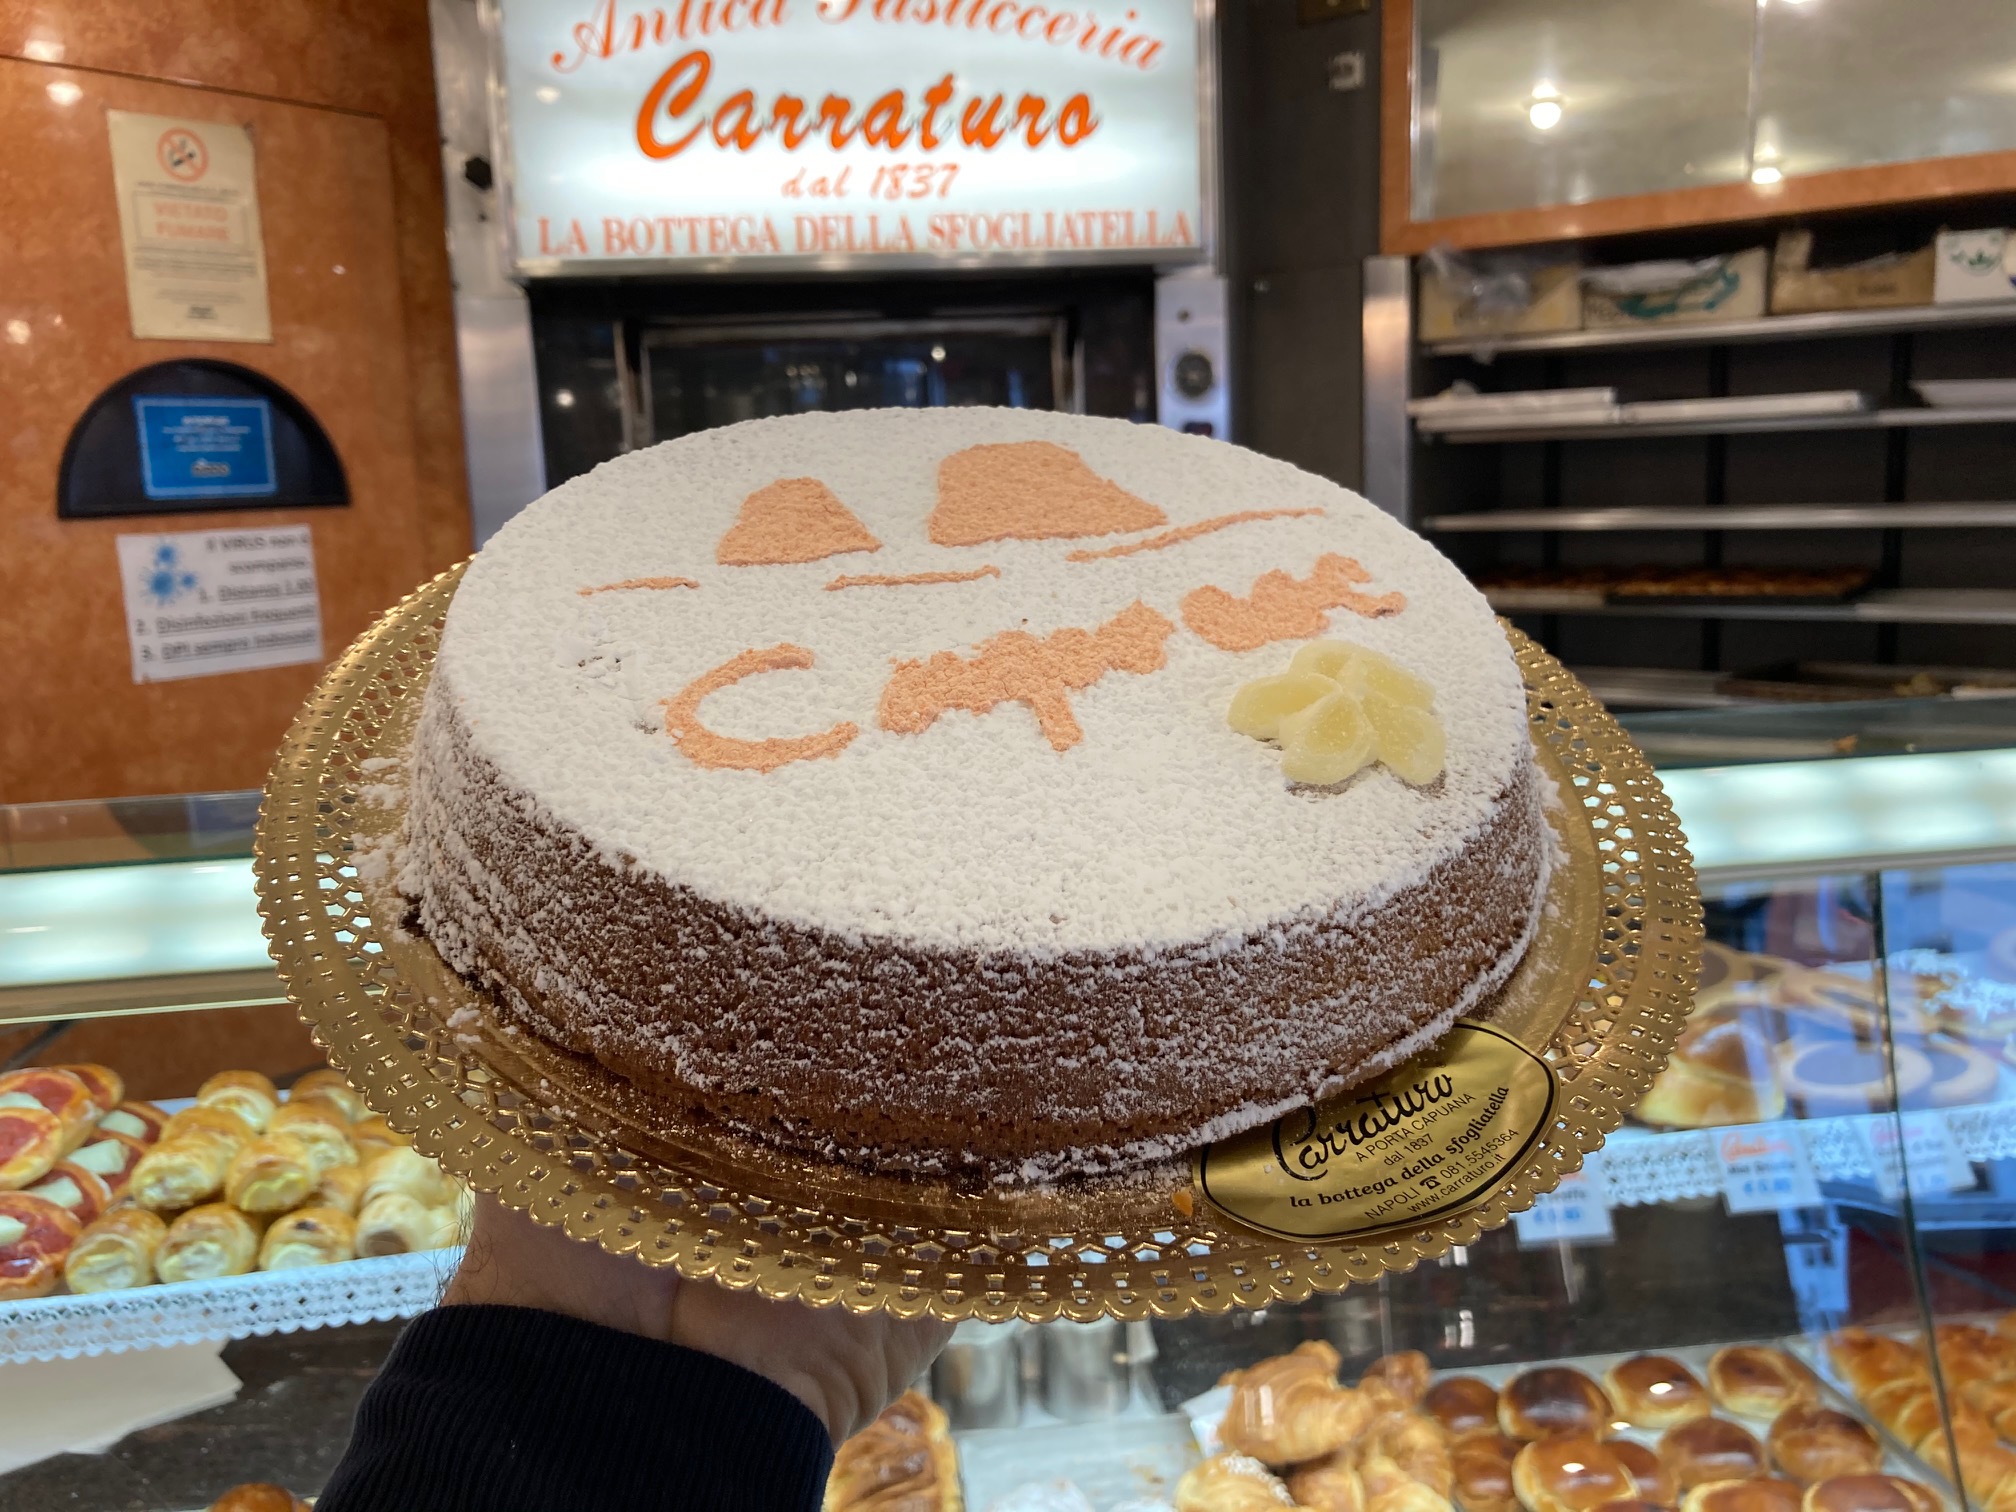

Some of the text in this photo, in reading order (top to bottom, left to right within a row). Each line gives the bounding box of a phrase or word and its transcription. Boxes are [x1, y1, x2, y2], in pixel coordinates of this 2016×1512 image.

[636, 51, 1101, 160] Carraturo
[781, 163, 960, 199] dal 1837
[537, 209, 1195, 256] LA BOTTEGA DELLA SFOGLIATELLA
[1271, 1073, 1453, 1181] Carraturo
[1290, 1086, 1510, 1208] la bottega della sfogliatella
[1355, 1093, 1476, 1162] A PORTA CAPUANA
[1383, 1133, 1434, 1166] dal 1837
[1364, 1187, 1421, 1220] NAPOLI
[1407, 1153, 1507, 1213] www.carraturo.it
